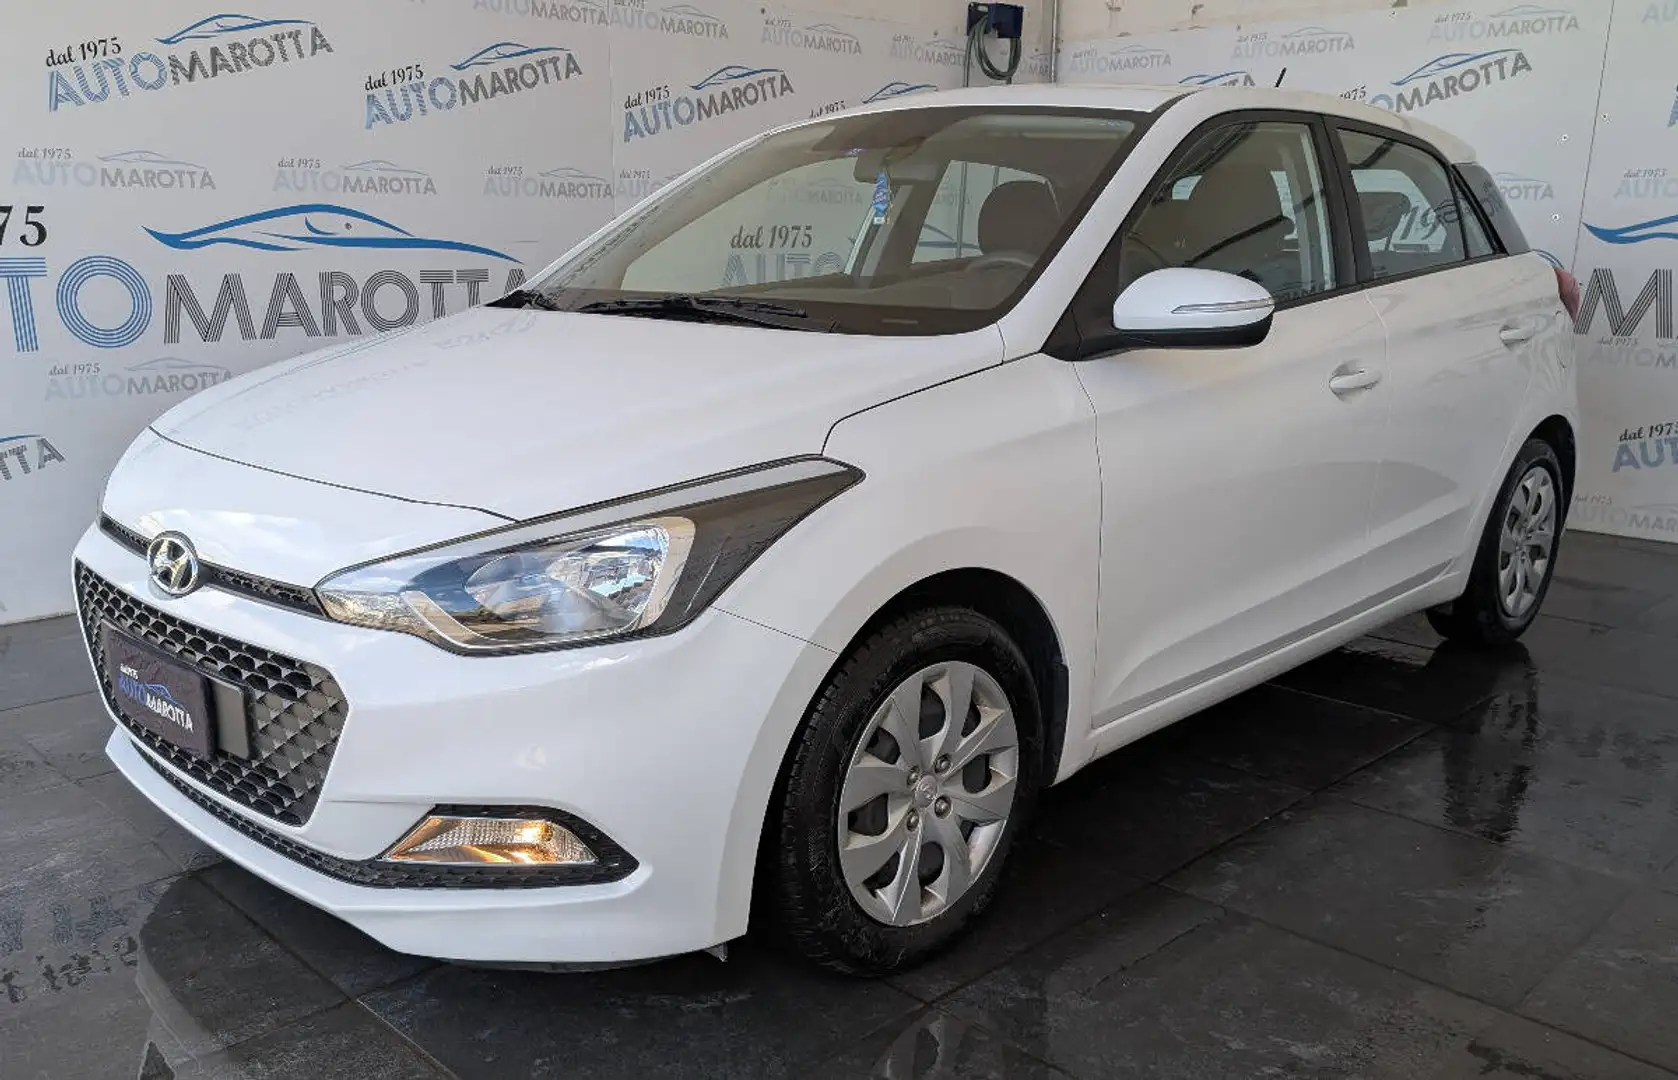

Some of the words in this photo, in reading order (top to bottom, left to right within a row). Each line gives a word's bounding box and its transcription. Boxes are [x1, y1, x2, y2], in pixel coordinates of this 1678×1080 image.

[1427, 16, 1580, 44] AUTOMAROTTA
[46, 45, 76, 67] dal
[79, 36, 122, 61] 1975
[1232, 36, 1355, 60] AUTOMAROTTA
[48, 24, 334, 113] AUTOMAROTTA
[364, 71, 387, 91] dal
[391, 64, 424, 86] 1975
[365, 52, 583, 130] AUTOMAROTTA
[623, 92, 642, 110] dal
[643, 85, 670, 106] 1975
[623, 69, 795, 142] AUTOMAROTTA
[17, 147, 39, 160] dal
[42, 148, 71, 160] 1975
[278, 157, 295, 169] dal
[297, 158, 320, 169] 1975
[12, 161, 216, 191] AUTOMAROTTA
[272, 170, 437, 196] AUTOMAROTTA
[483, 177, 614, 200] AUTOMAROTTA
[731, 225, 763, 249] dal
[769, 224, 813, 249] 1975
[48, 365, 70, 376] dal
[73, 363, 100, 376] 1975
[1619, 426, 1644, 441] dal
